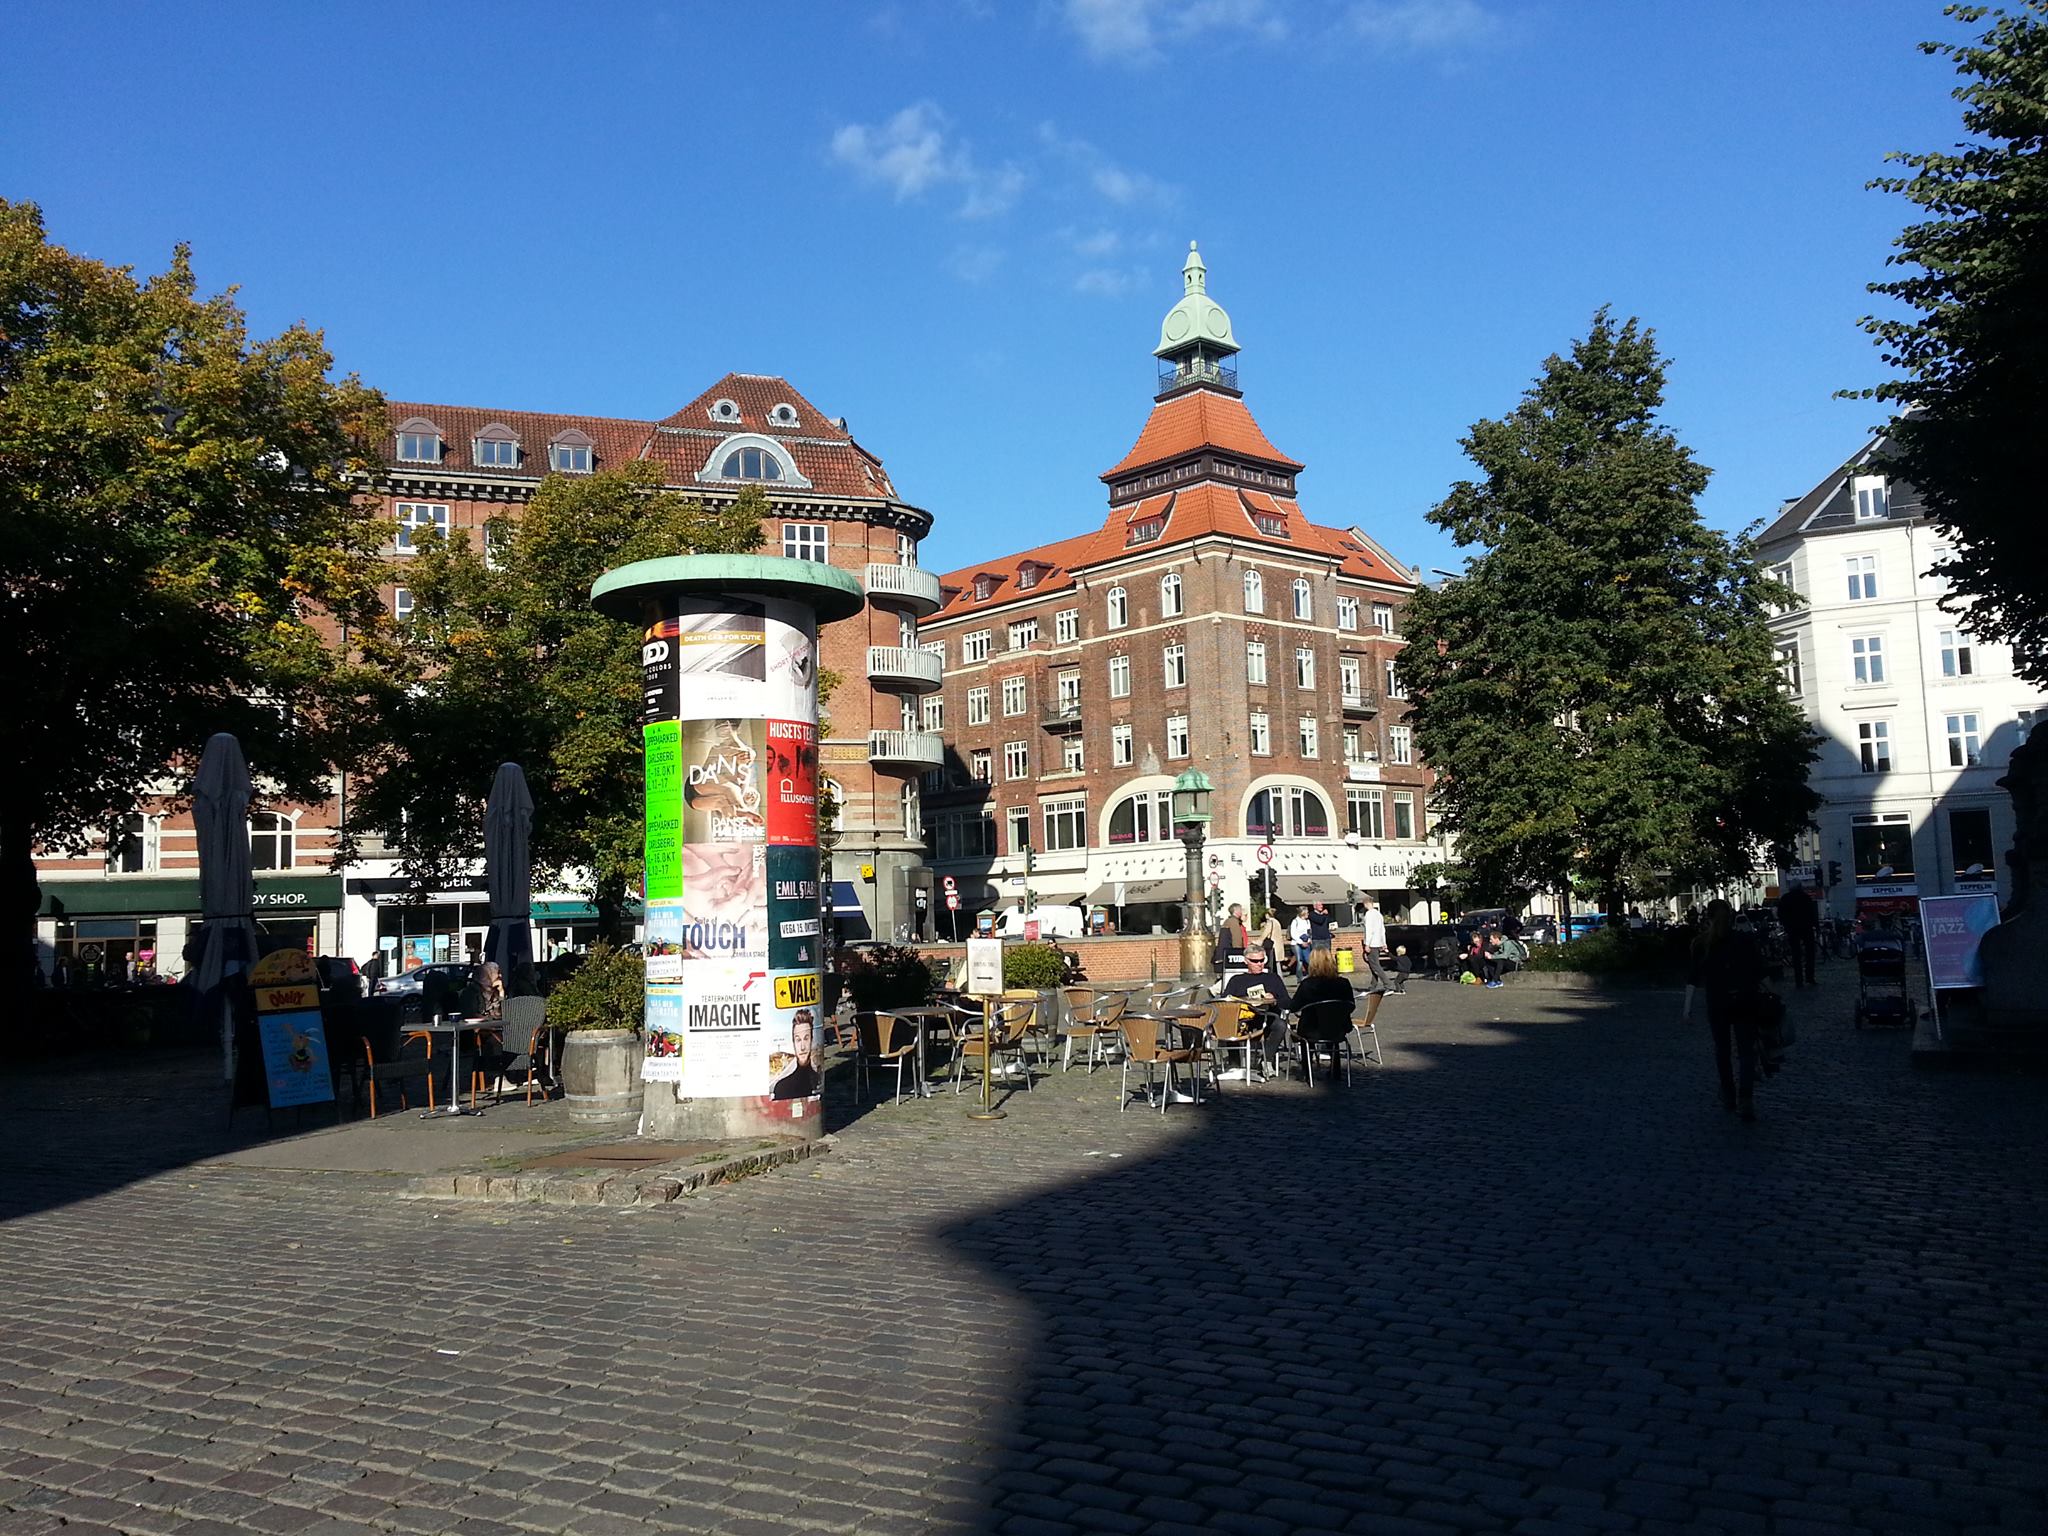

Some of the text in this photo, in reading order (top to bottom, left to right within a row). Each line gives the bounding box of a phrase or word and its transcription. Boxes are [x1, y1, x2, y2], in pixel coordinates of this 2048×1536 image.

[648, 663, 672, 674] COLORS
[769, 722, 802, 740] HUSETS
[776, 881, 798, 897] EMIL
[682, 923, 746, 951] TOUCH
[781, 924, 796, 936] VEGA
[1930, 923, 1966, 938] JAZZ
[268, 989, 305, 1007] Obelix
[788, 978, 816, 1004] VALG
[689, 1003, 761, 1028] IMAGINE
